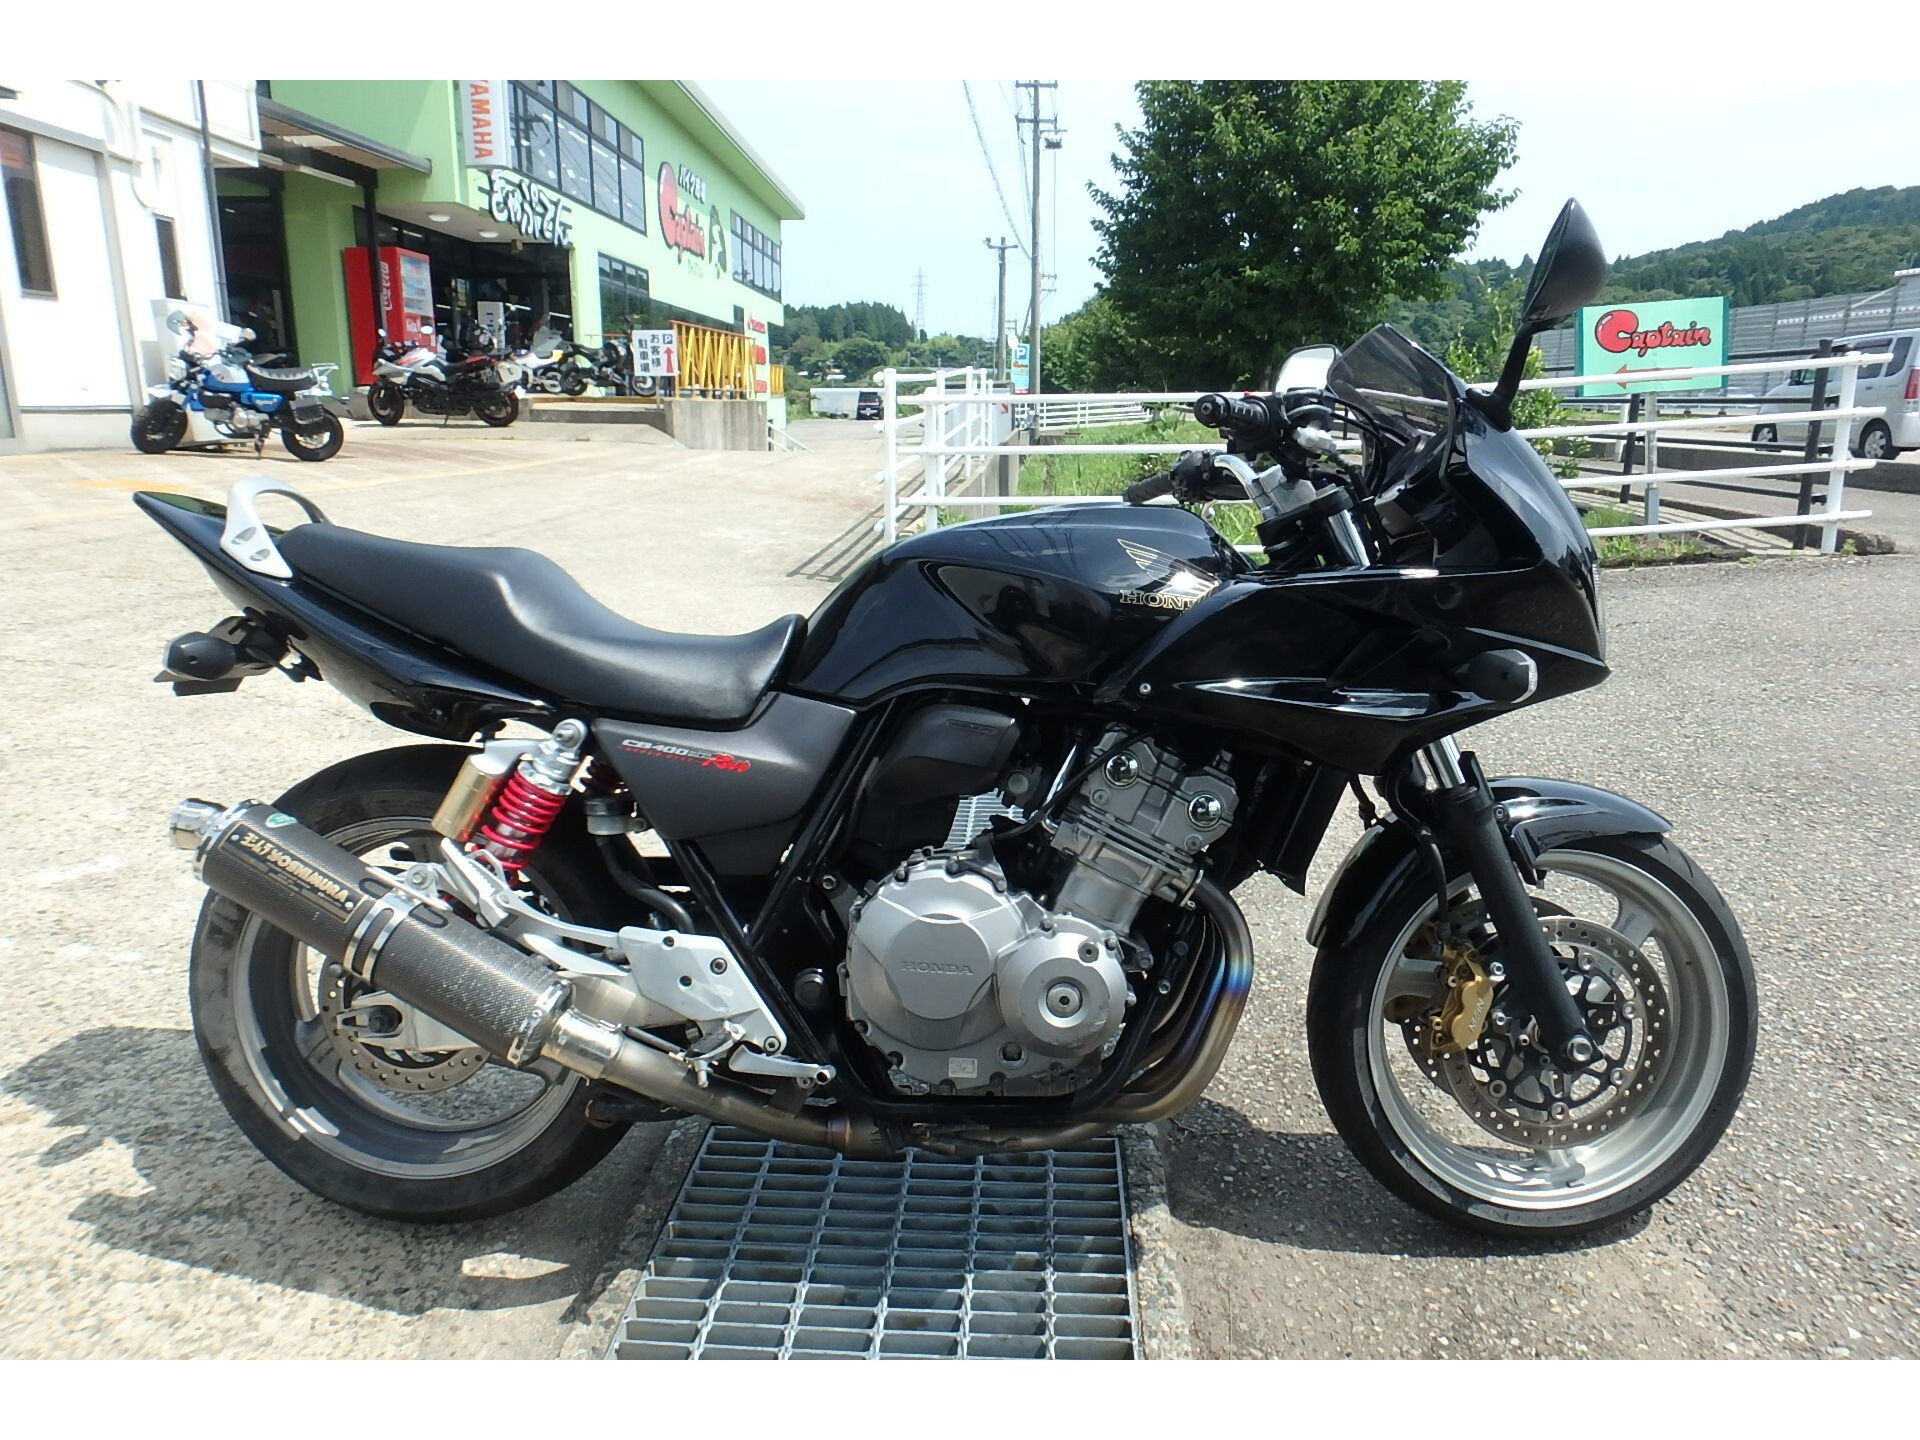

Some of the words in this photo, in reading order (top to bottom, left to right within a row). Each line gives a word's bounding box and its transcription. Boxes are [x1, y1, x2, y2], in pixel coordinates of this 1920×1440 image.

[470, 80, 493, 159] AMAHA
[658, 161, 706, 264] Captain
[638, 338, 650, 373] 駐車場
[650, 334, 661, 367] お客様
[1595, 309, 1711, 357] Captain
[267, 848, 349, 903] YOSHIMURA
[900, 960, 975, 976] HONDA
